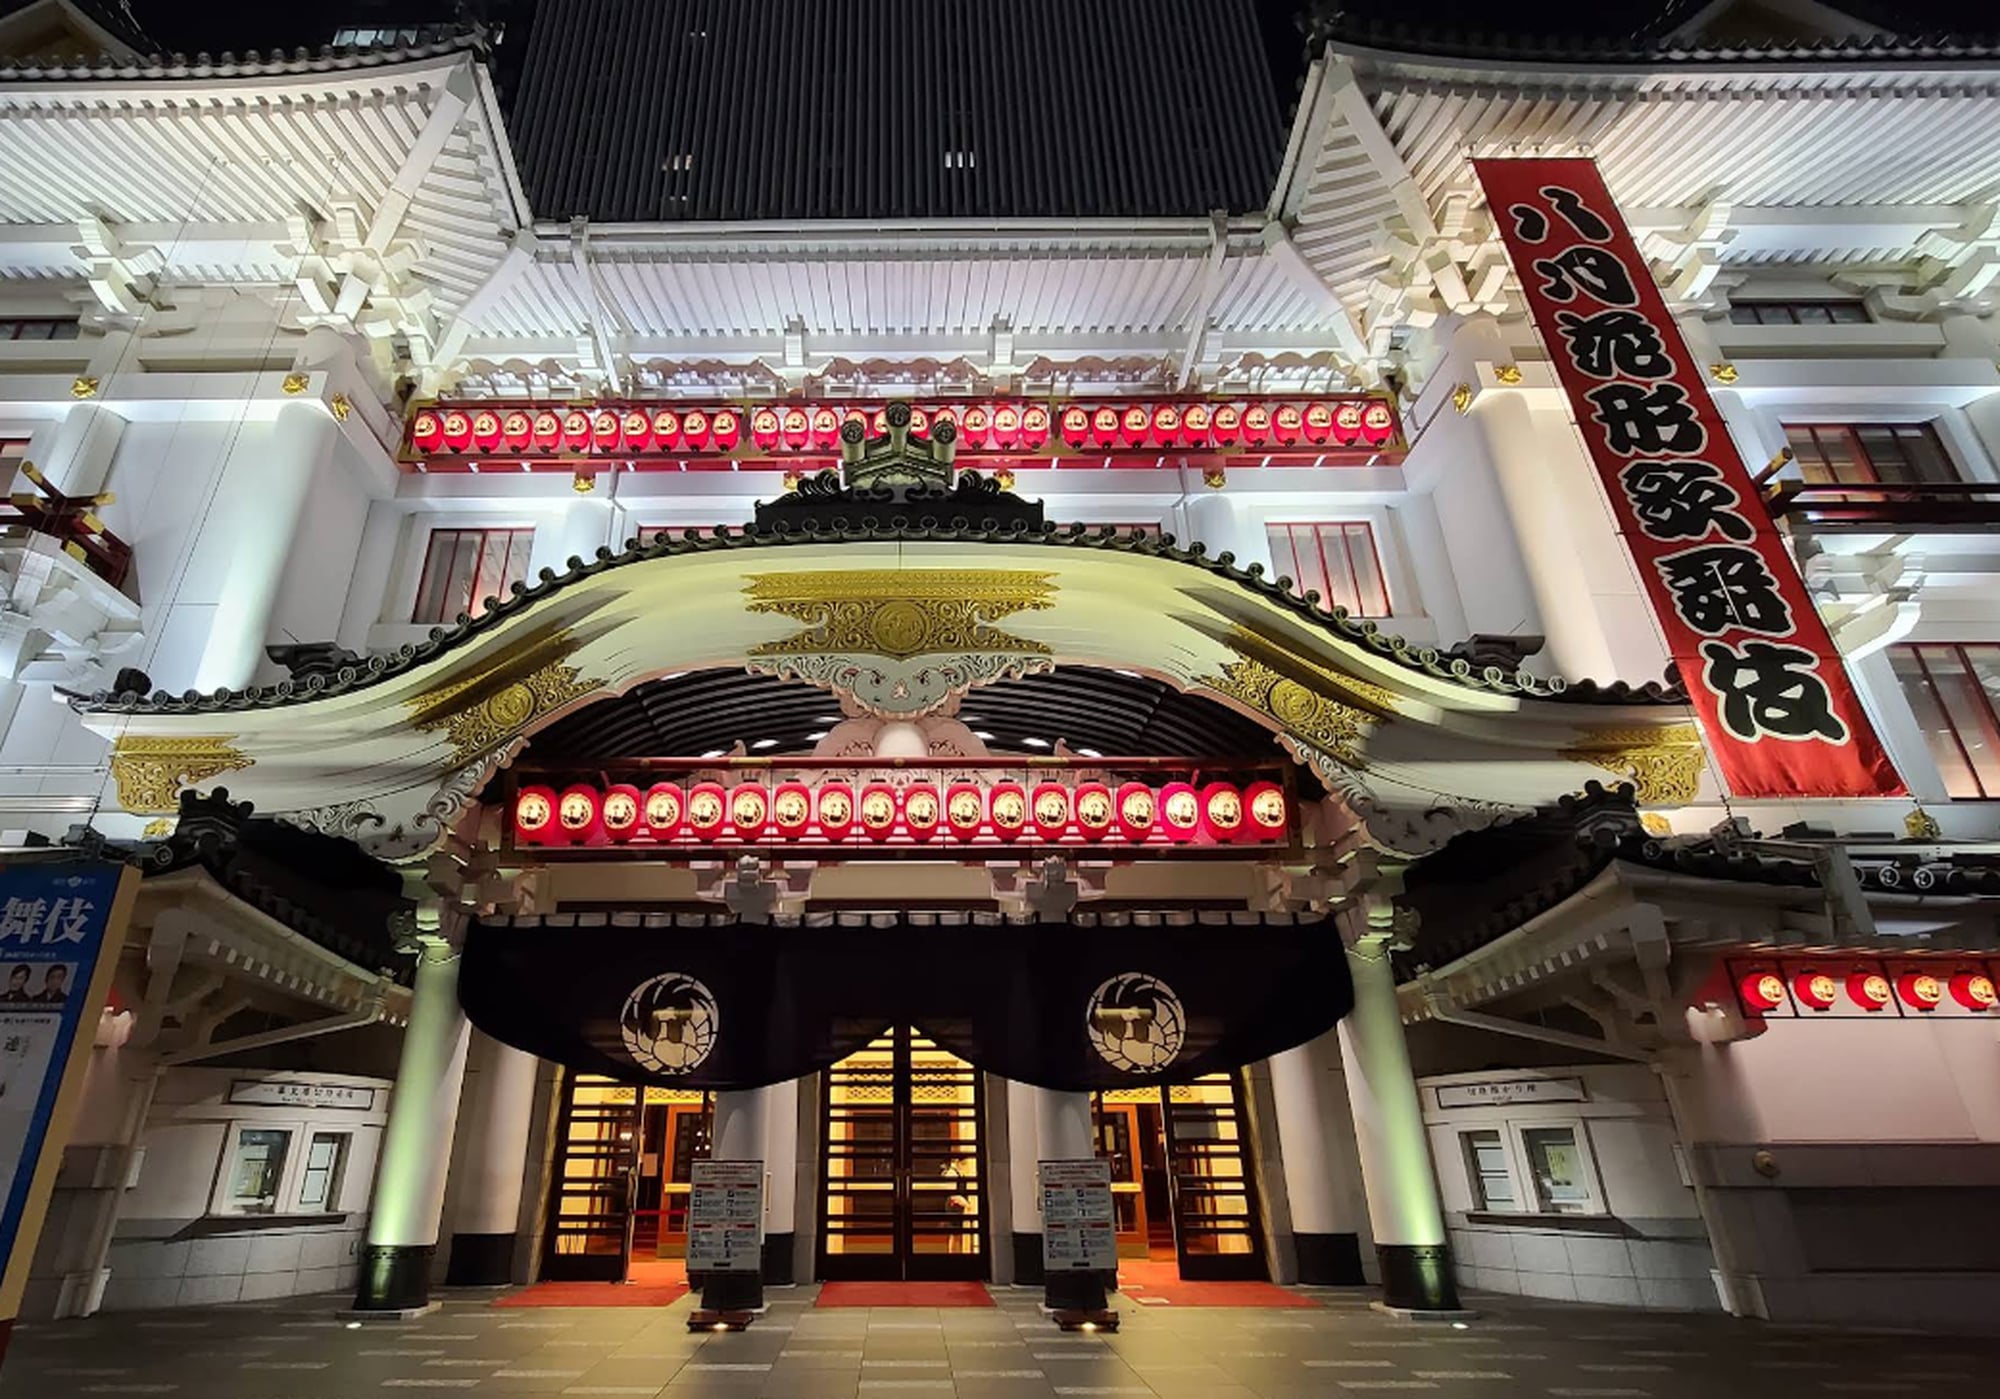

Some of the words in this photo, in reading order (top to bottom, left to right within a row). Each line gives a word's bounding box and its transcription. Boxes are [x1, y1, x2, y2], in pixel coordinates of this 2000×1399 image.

[1508, 186, 1850, 745] 八月花形歌舞伎
[0, 896, 95, 944] 舞伎
